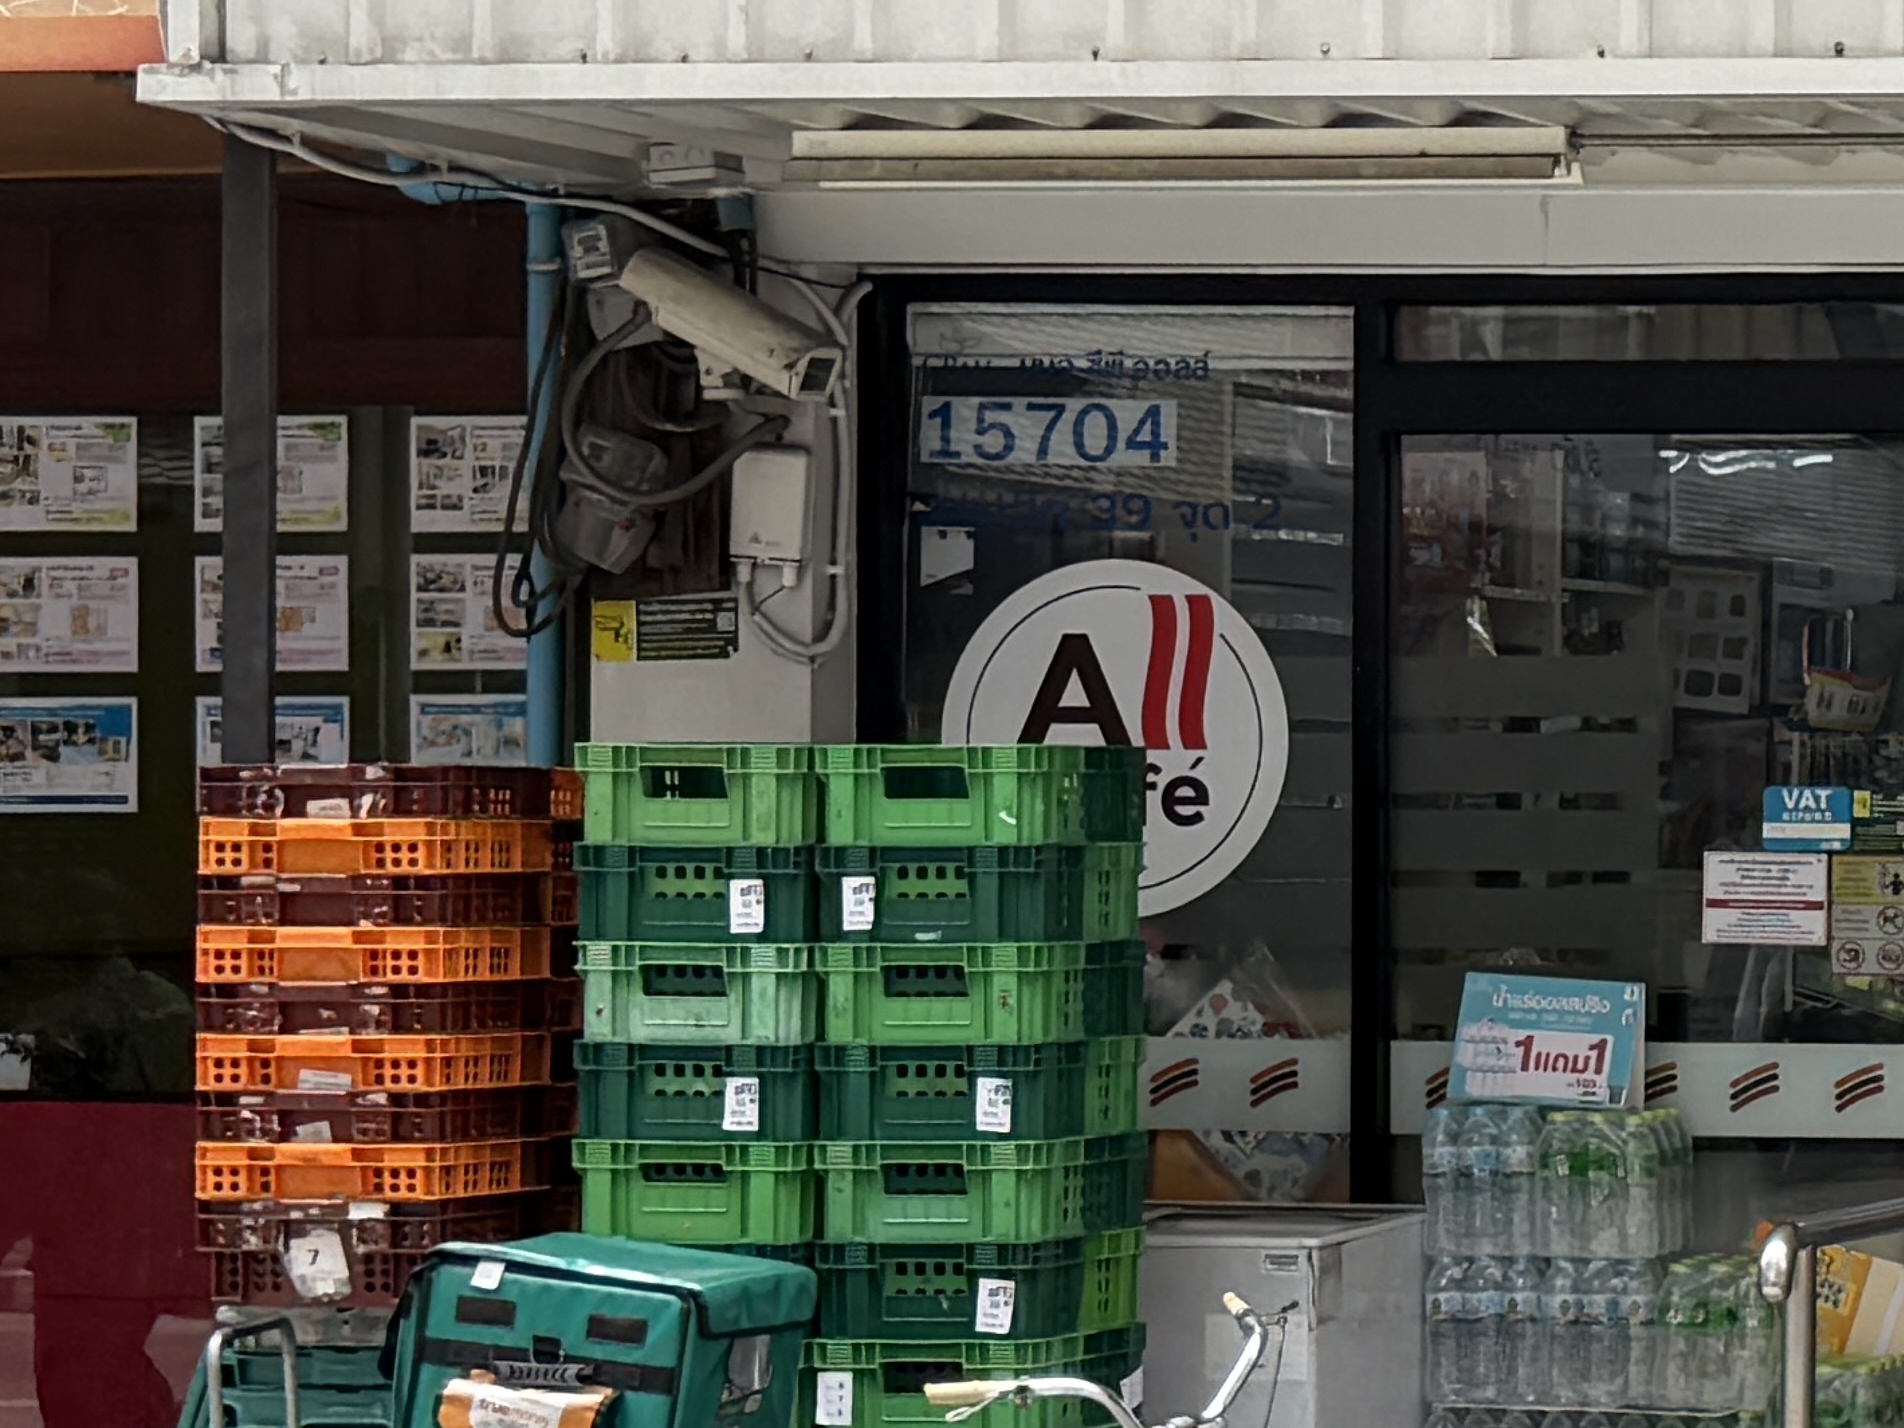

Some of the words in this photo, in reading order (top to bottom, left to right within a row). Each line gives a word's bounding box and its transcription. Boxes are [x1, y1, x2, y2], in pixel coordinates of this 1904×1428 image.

[927, 400, 1170, 463] 15704
[1017, 593, 1215, 750] All
[1145, 756, 1210, 827] fé
[1781, 788, 1833, 809] VAT
